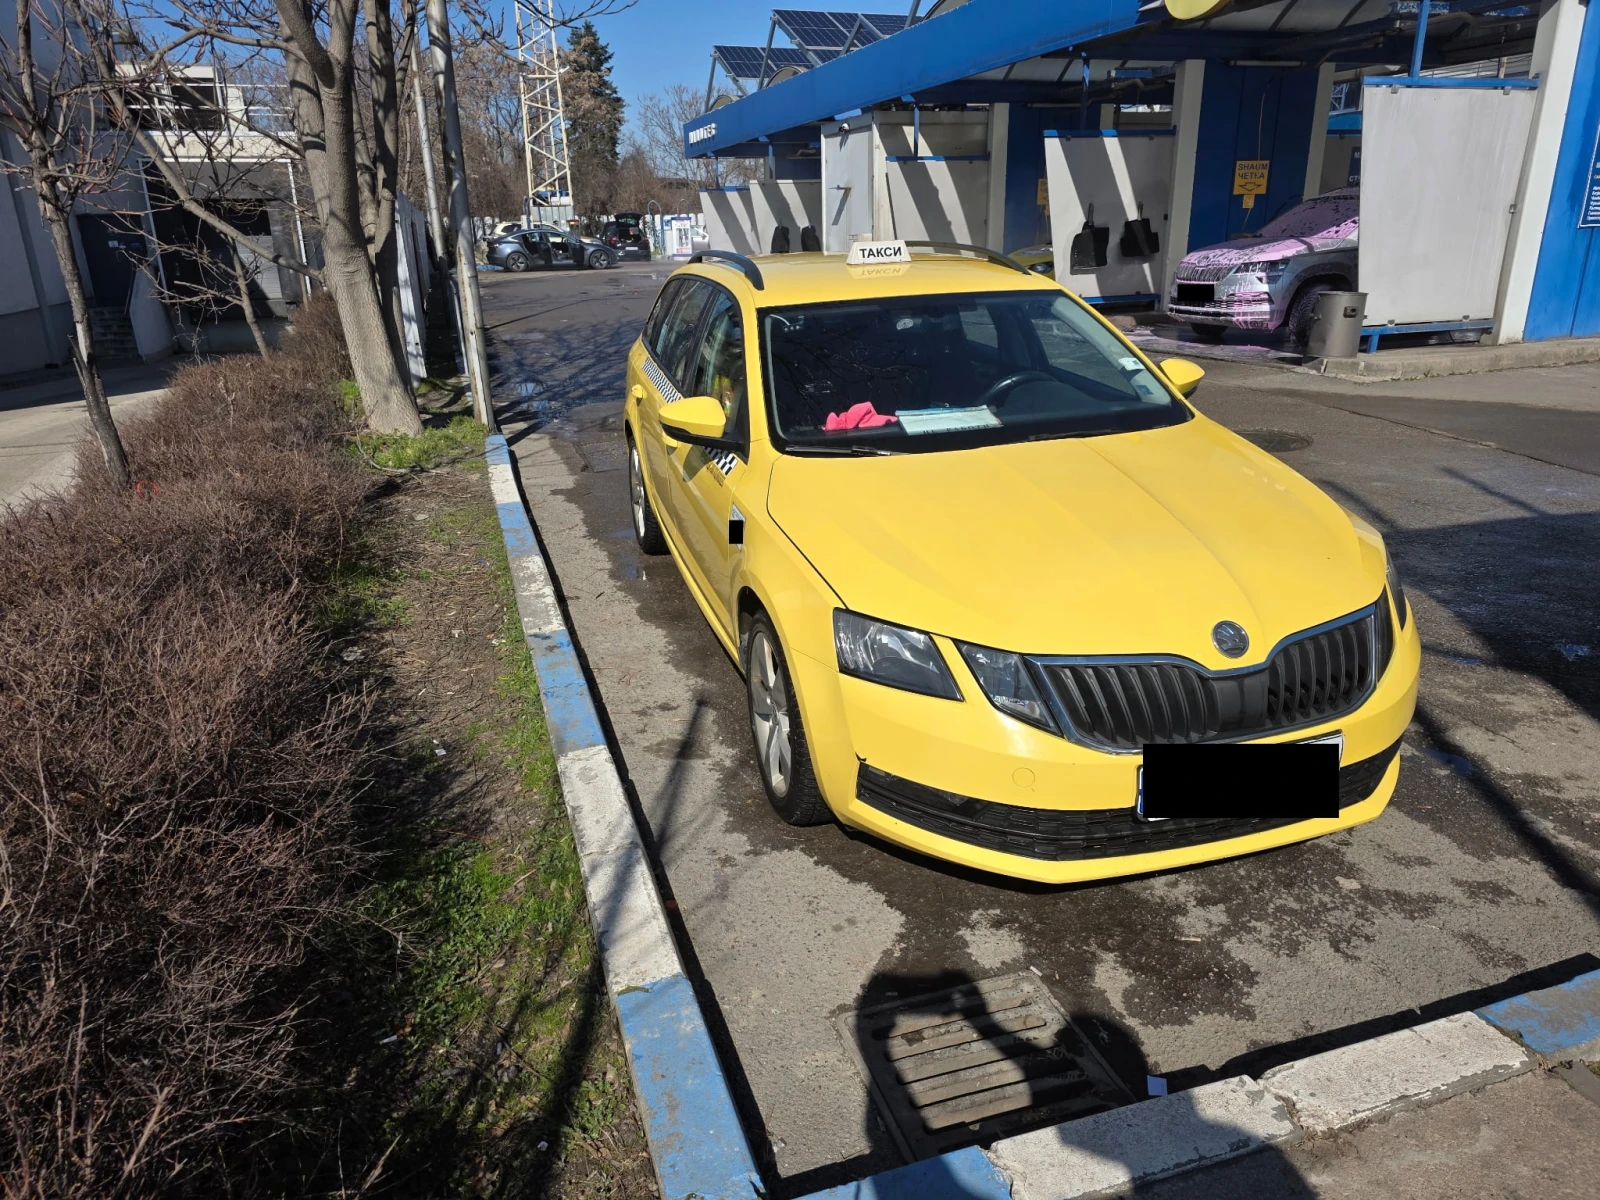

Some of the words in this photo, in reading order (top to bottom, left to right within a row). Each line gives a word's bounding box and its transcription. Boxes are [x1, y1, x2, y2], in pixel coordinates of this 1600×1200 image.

[1238, 163, 1268, 171] SHAUM
[1238, 172, 1265, 180] ЧЕТКА
[859, 246, 902, 258] ТАКСИ
